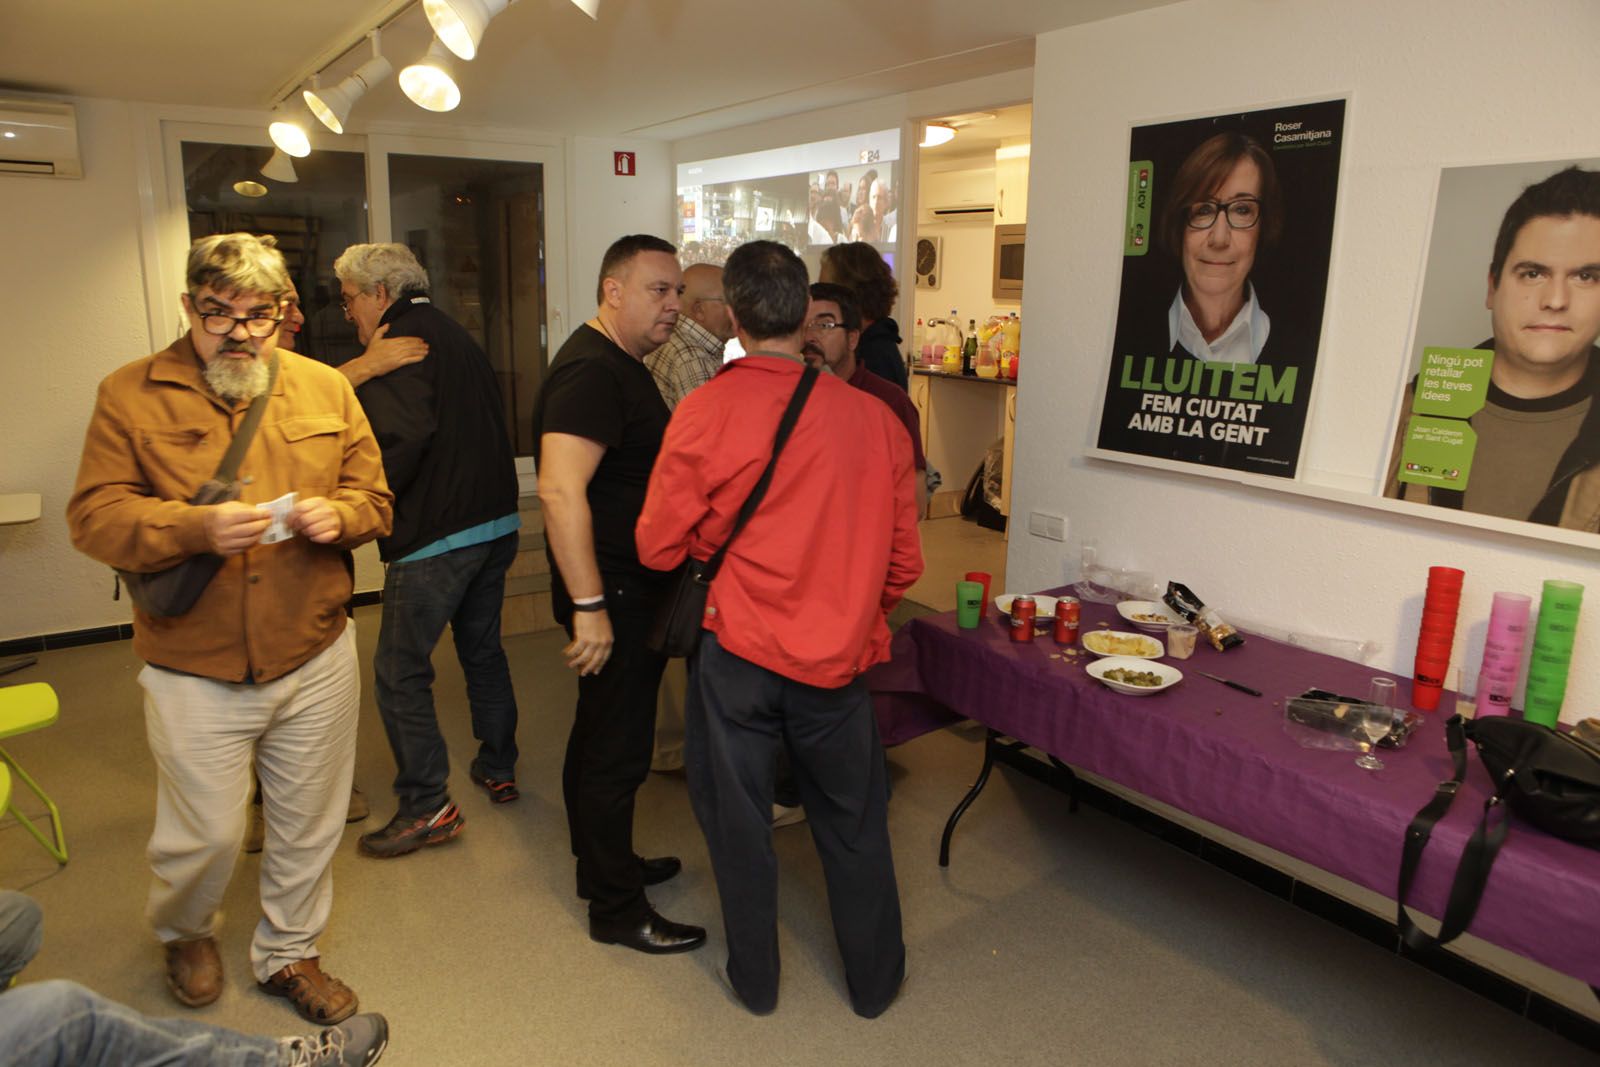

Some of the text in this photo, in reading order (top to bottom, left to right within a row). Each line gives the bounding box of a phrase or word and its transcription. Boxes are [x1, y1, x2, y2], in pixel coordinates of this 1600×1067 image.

[1275, 122, 1303, 132] Roser
[1274, 130, 1332, 143] Casamitjana
[1428, 354, 1484, 369] Ningú pot
[1120, 355, 1299, 404] LLUITEM
[1425, 366, 1465, 379] retallar
[1424, 378, 1473, 392] les teves
[1421, 391, 1451, 402] idees
[1141, 393, 1262, 423] FEM CIUTAT
[1128, 413, 1270, 447] AMB LA GENT
